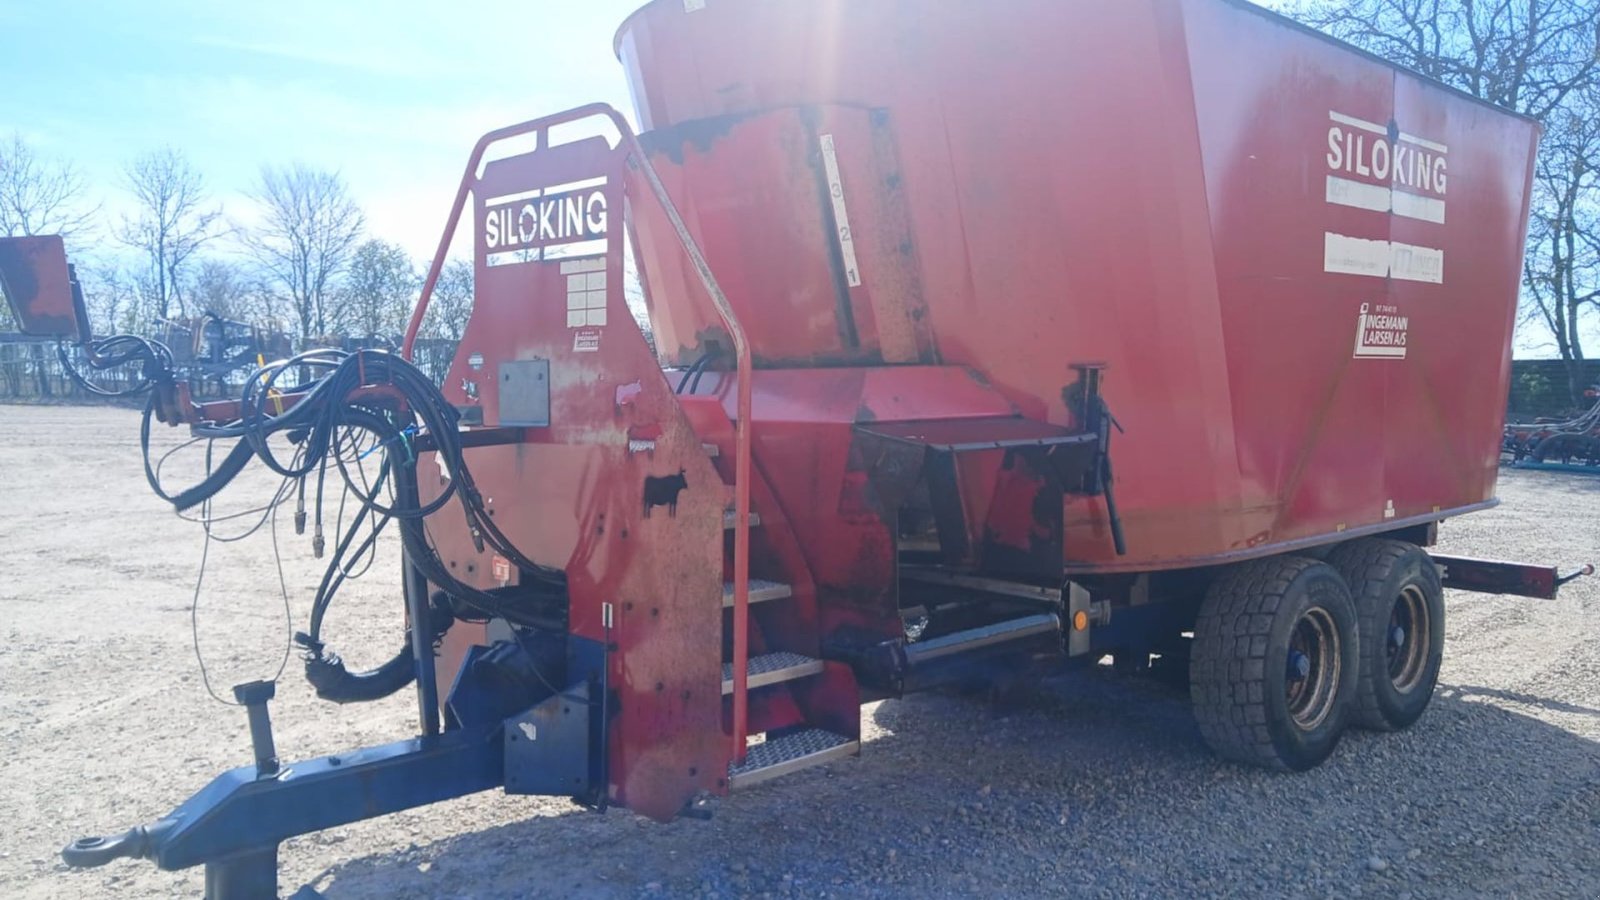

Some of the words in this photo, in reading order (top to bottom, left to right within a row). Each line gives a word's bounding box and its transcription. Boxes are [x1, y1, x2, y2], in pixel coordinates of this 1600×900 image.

[1327, 126, 1447, 195] SILOKING
[831, 183, 841, 198] 3
[485, 191, 607, 248] SILOKING
[840, 226, 850, 242] 2
[848, 268, 856, 283] 1
[1365, 314, 1408, 330] INGEMANN
[1364, 330, 1394, 345] LARSEN
[1393, 331, 1407, 345] A/S
